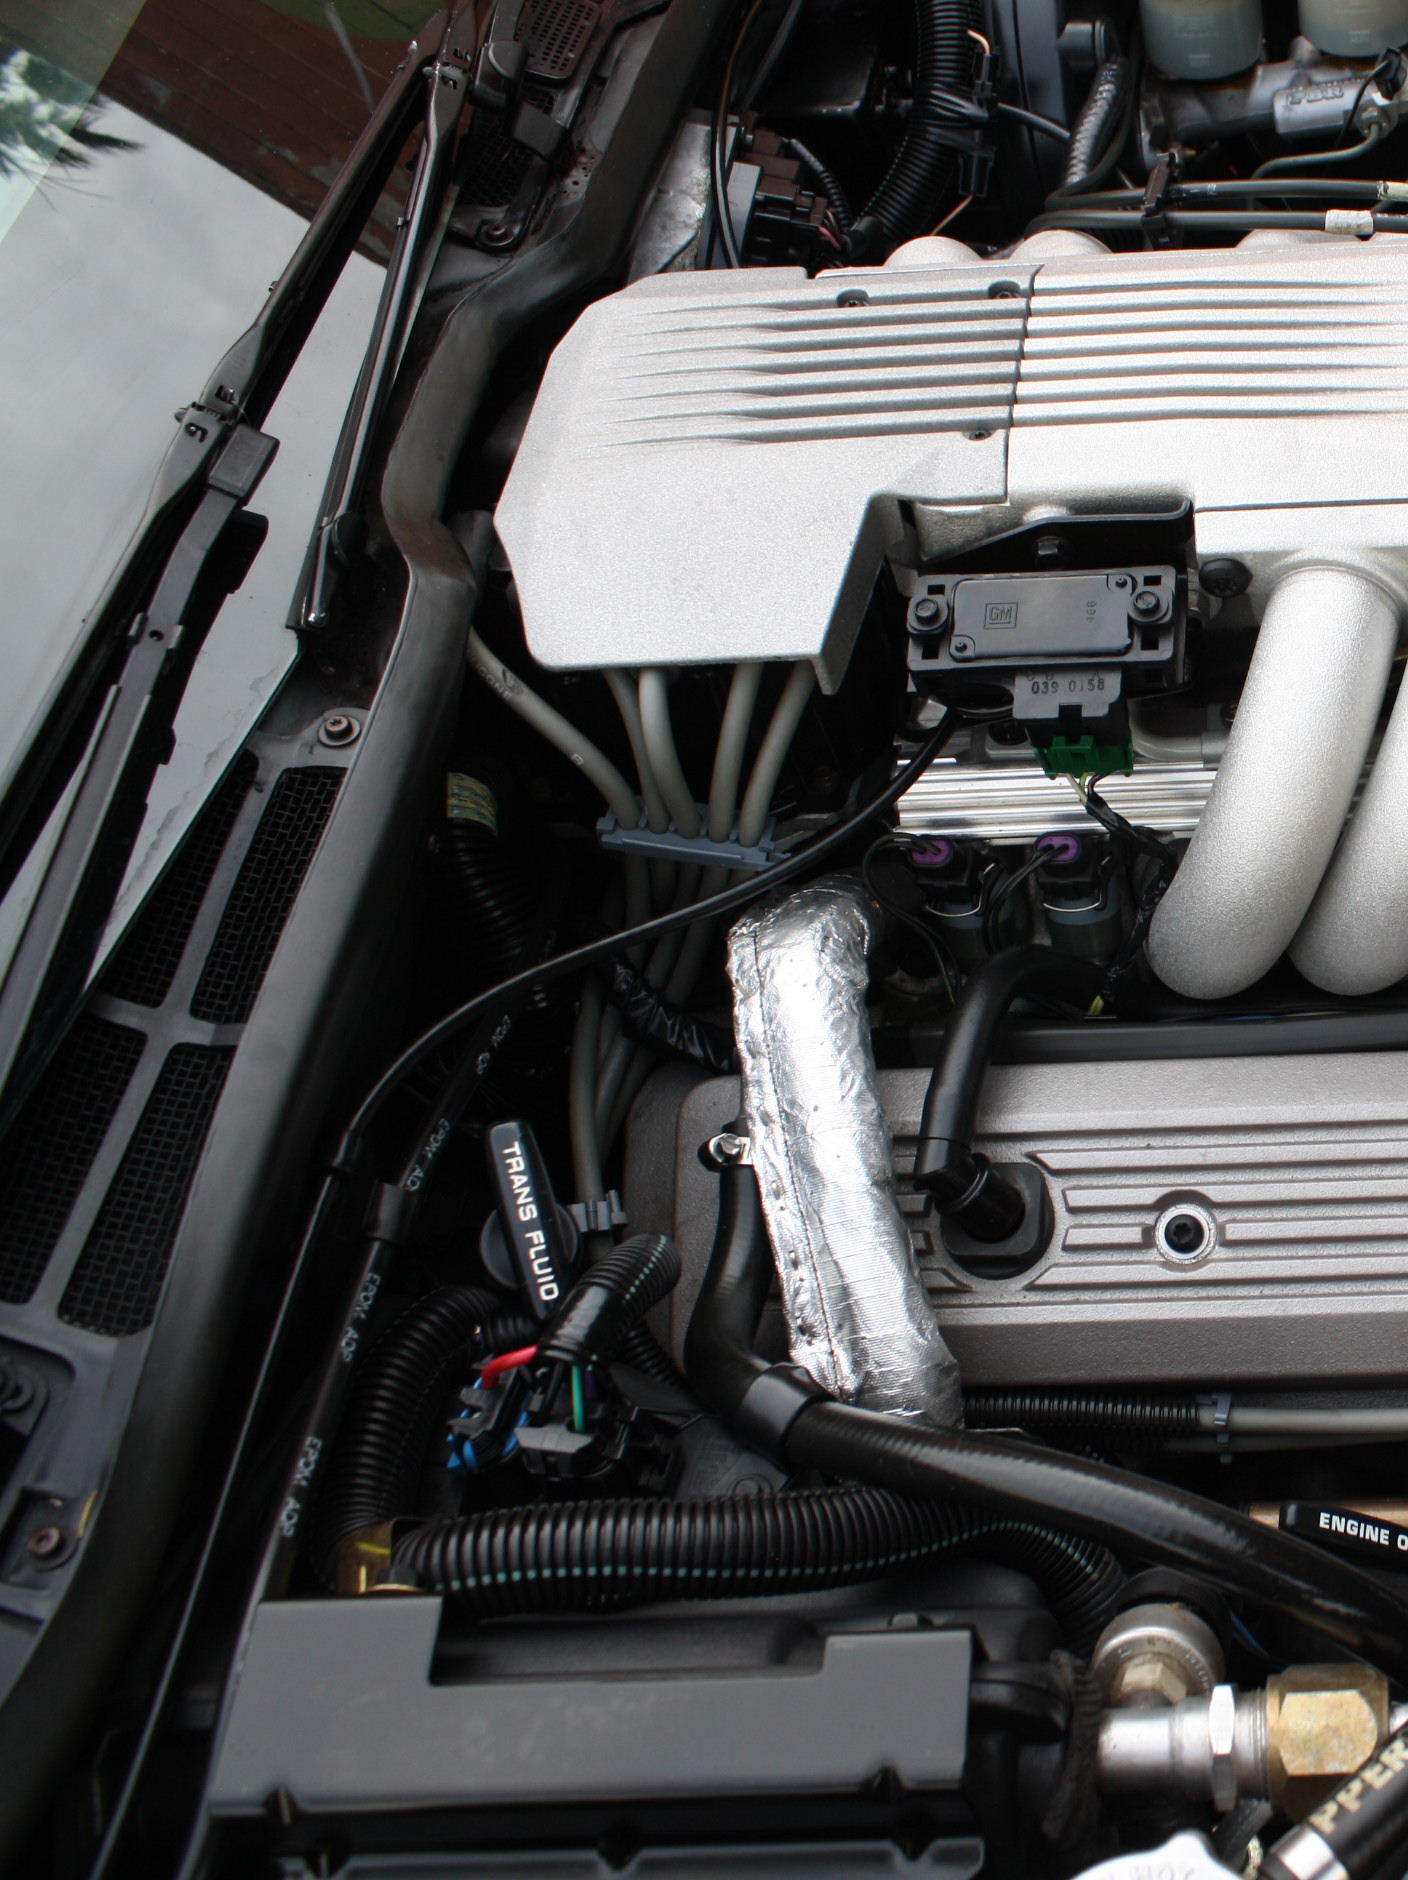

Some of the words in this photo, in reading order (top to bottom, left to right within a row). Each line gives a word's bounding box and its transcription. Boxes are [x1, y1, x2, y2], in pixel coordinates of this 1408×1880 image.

[988, 606, 1013, 624] GM
[1031, 680, 1059, 694] 039
[503, 1141, 538, 1222] TRANS
[524, 1230, 560, 1301] FLUID
[1319, 1511, 1390, 1546] ENGINE
